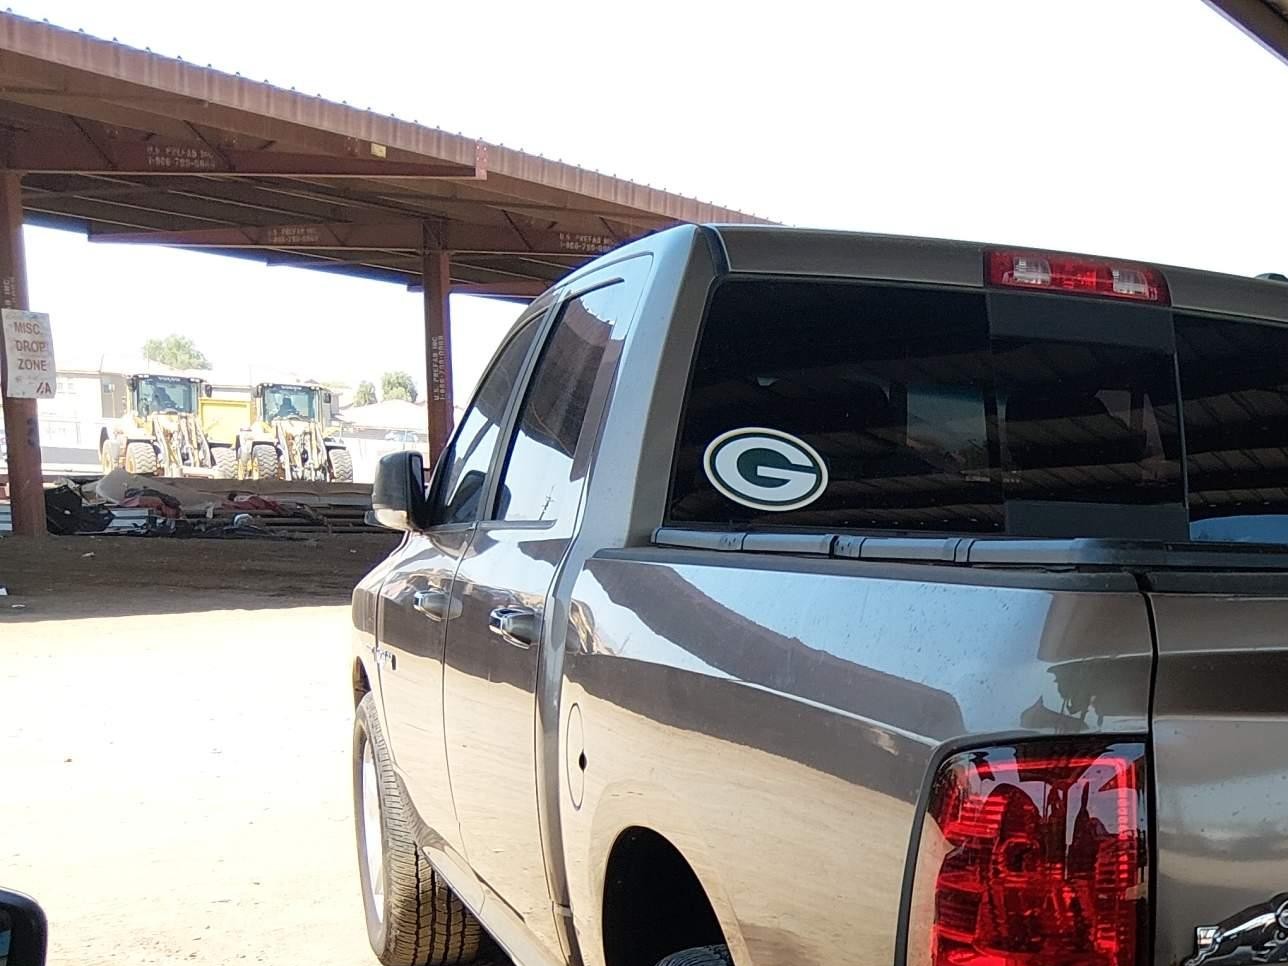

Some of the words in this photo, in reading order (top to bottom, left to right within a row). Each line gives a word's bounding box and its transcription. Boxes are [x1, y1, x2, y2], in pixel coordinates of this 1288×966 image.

[15, 340, 46, 354] DROP
[18, 358, 47, 372] ZONE
[715, 437, 817, 501] G
